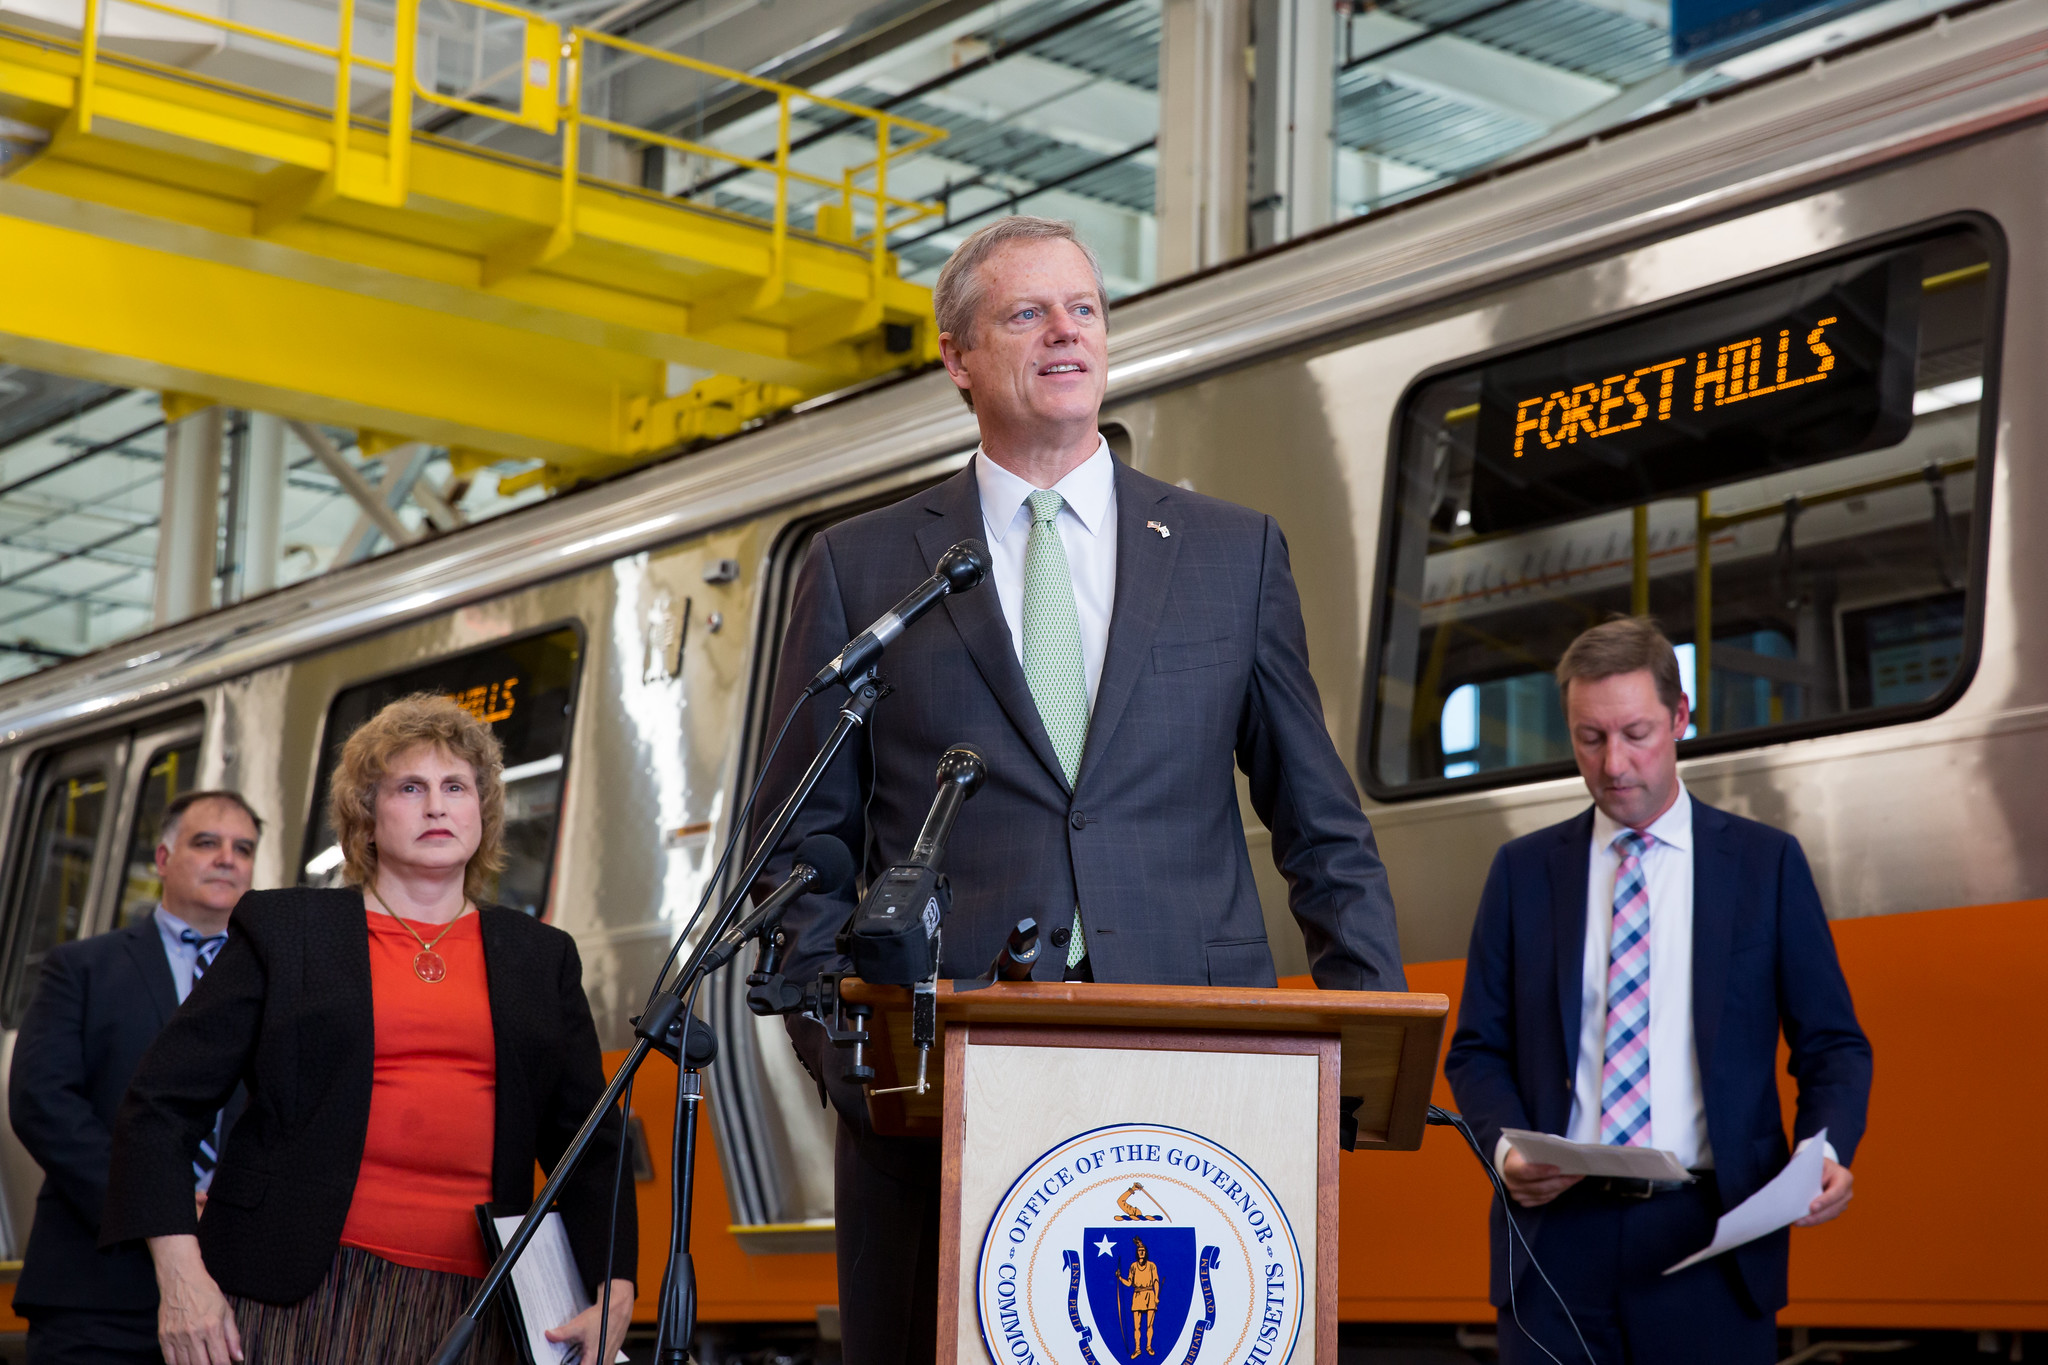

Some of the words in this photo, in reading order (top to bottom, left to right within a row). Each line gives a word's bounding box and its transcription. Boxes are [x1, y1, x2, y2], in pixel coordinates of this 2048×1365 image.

[1513, 358, 1687, 458] FOREST
[1693, 316, 1838, 412] HILLS
[1009, 1166, 1075, 1244] OFFICE
[1075, 1149, 1106, 1174] OF
[1109, 1144, 1161, 1164] THE
[1166, 1148, 1273, 1244] GOVERNOR
[1070, 1262, 1080, 1292] ENSE
[1200, 1258, 1215, 1314] QVIETEM
[1069, 1299, 1082, 1328] PETIT
